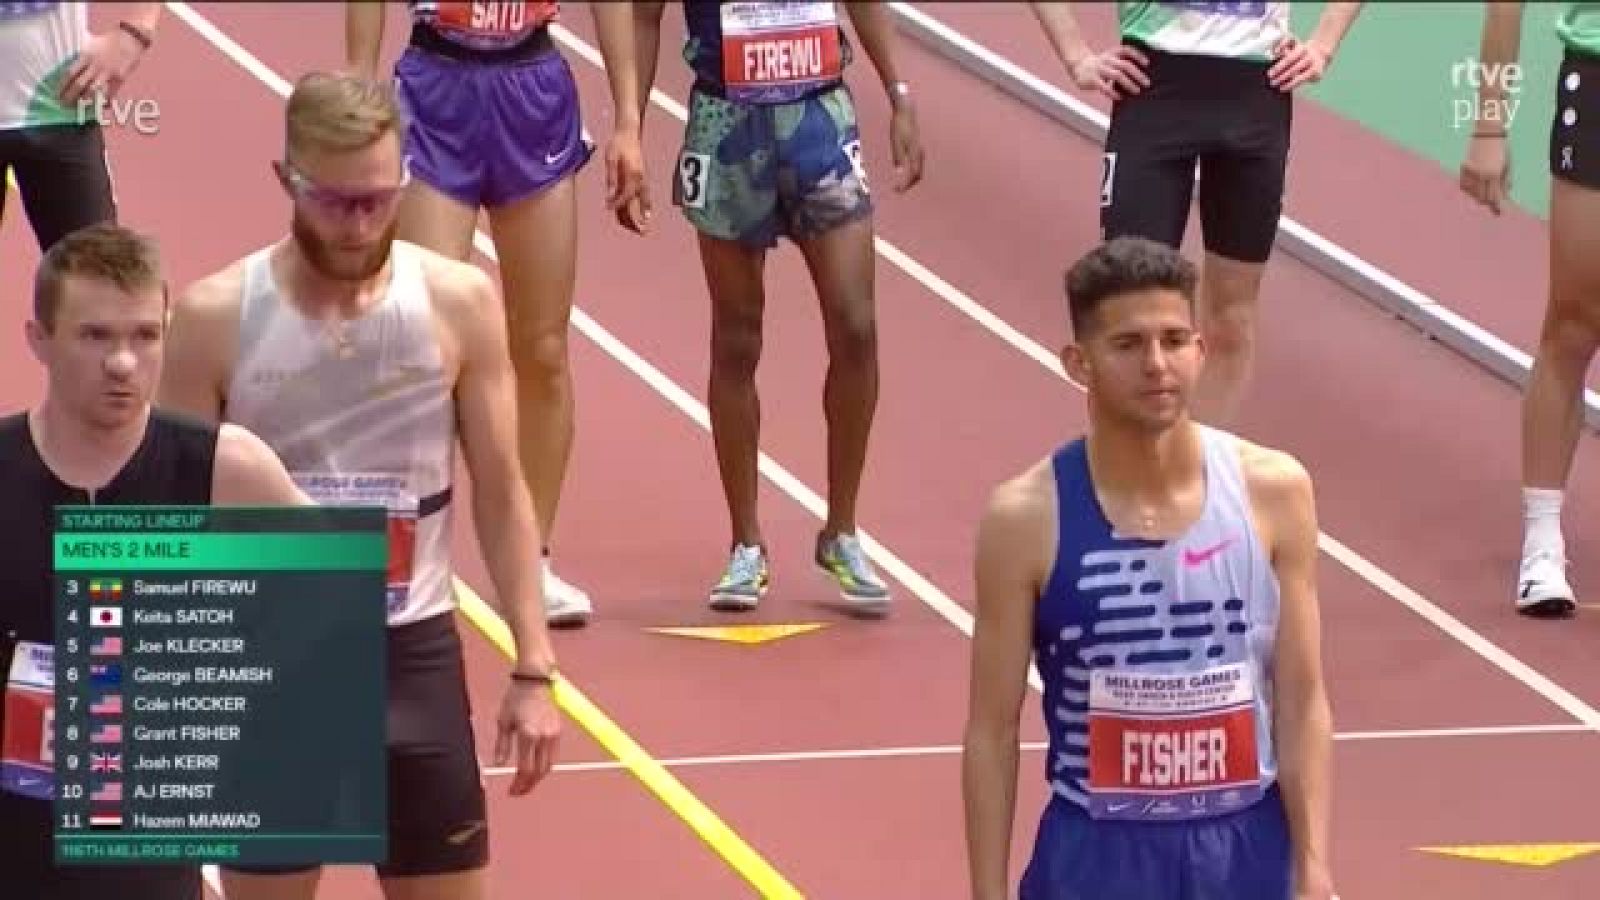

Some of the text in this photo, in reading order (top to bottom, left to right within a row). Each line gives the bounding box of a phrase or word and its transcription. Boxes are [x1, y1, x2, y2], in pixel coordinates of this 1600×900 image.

[744, 36, 821, 81] FIREWU
[683, 156, 701, 202] 3
[1104, 669, 1241, 690] MILLROSE GAMES
[1122, 728, 1227, 786] FISHER
